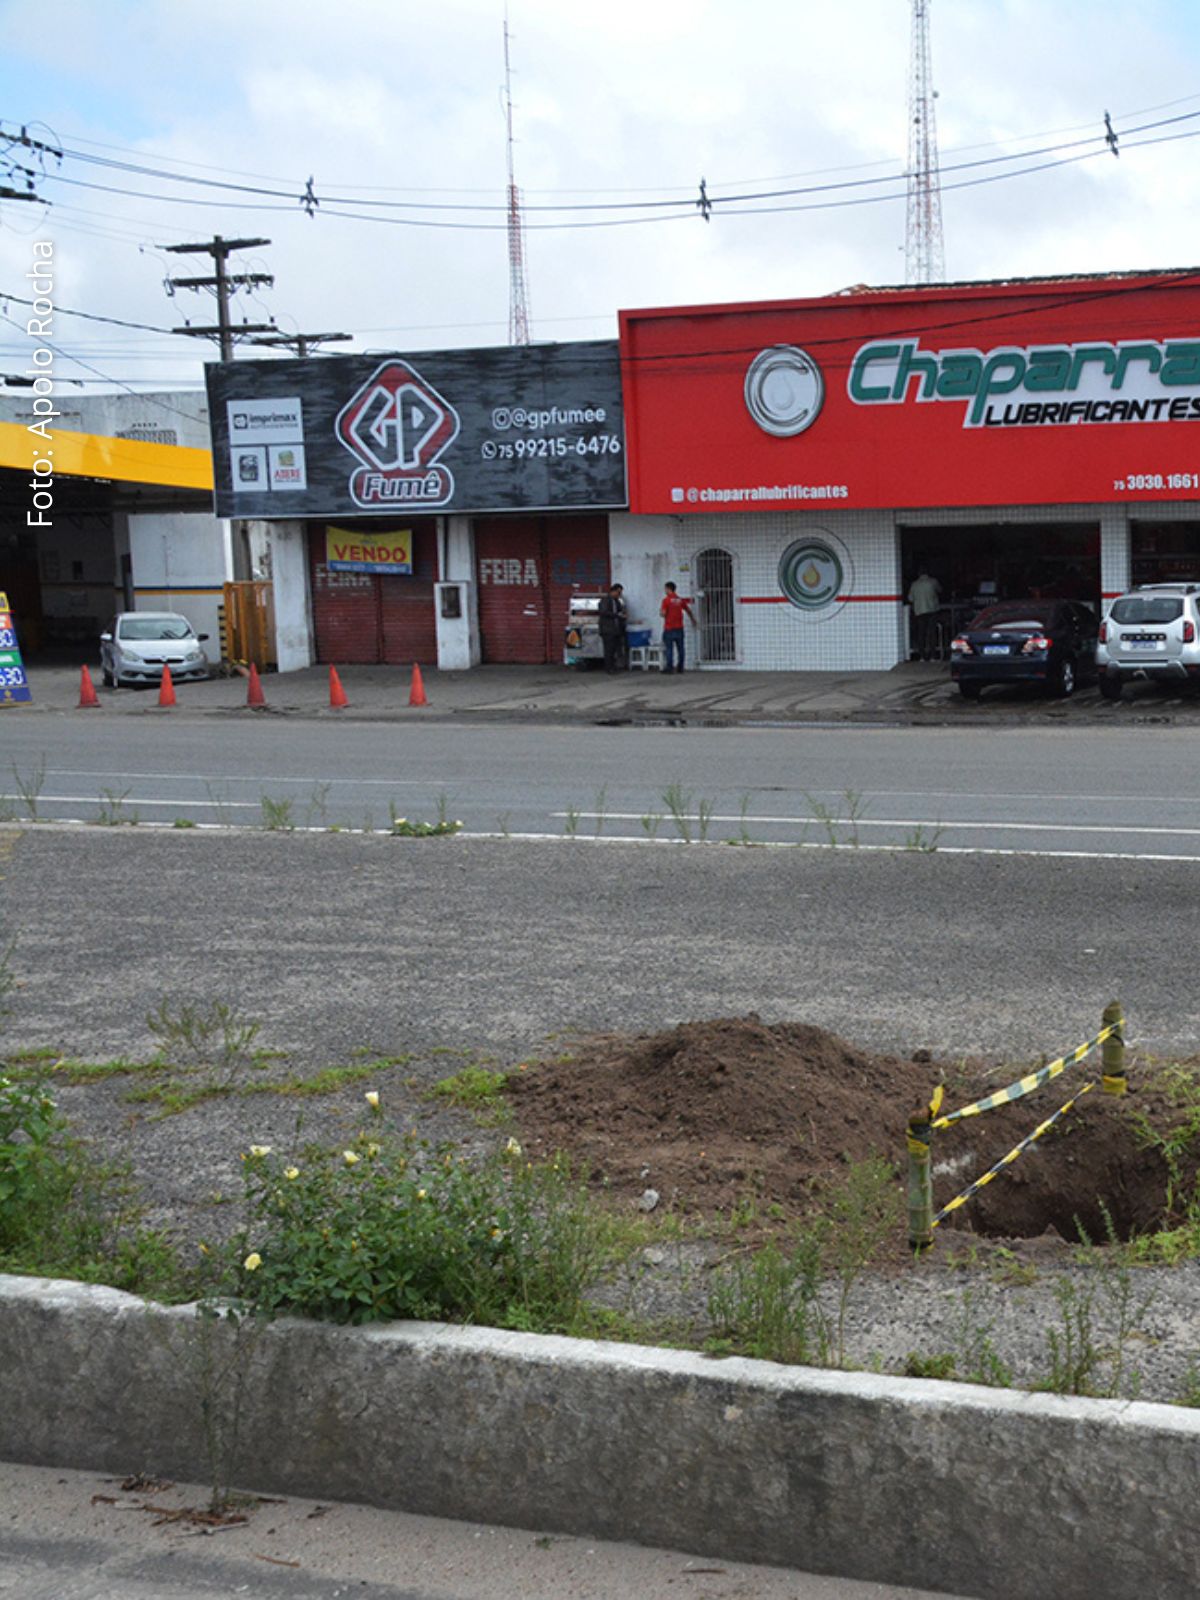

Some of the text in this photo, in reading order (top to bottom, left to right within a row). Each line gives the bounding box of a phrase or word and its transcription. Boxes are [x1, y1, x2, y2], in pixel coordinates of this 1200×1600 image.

[350, 383, 445, 470] GP
[511, 406, 606, 429] @gpfumee
[498, 434, 621, 459] 75 99215-6476
[362, 470, 442, 500] Fumê
[687, 485, 849, 503] @chaparrallubrificantes
[333, 543, 407, 563] VENDO
[480, 558, 539, 587] FEIRA
